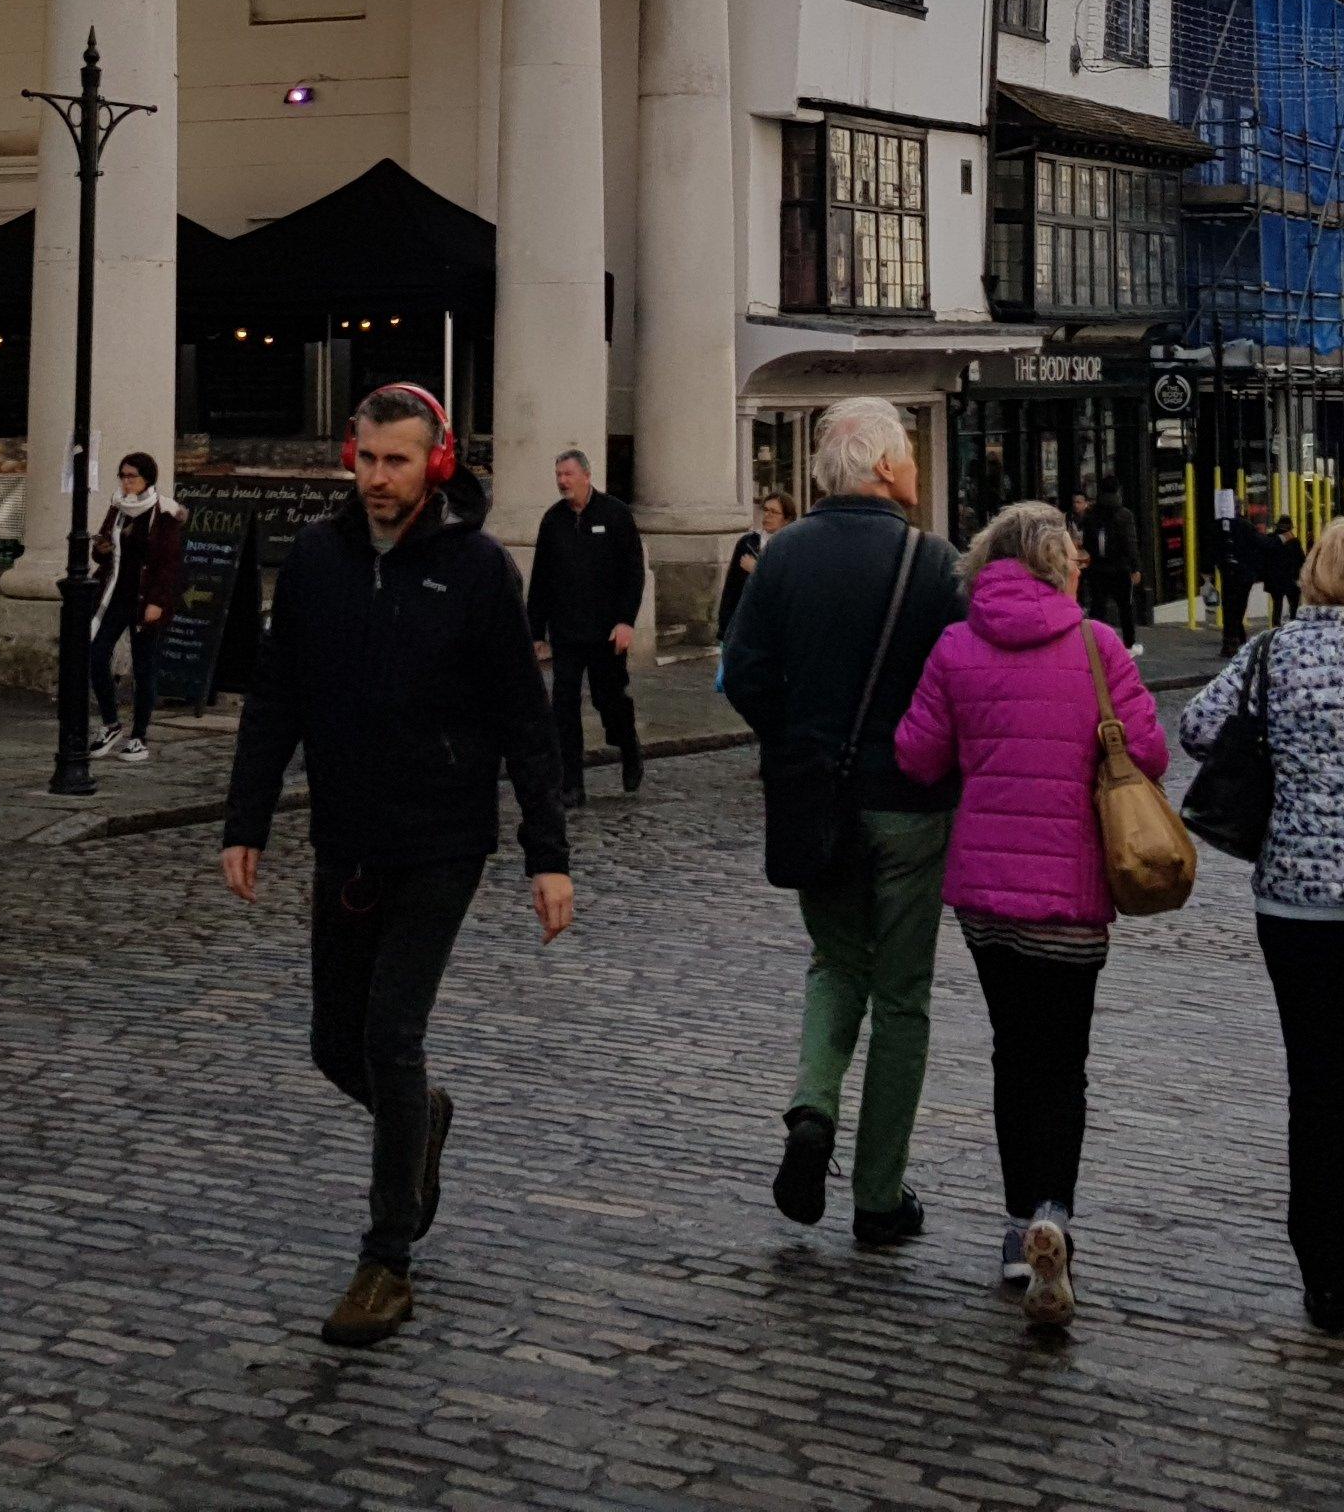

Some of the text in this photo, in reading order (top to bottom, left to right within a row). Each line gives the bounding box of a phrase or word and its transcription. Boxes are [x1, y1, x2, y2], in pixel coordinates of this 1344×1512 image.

[1014, 355, 1103, 382] THE BODY SHOP
[1162, 391, 1184, 399] BODY
